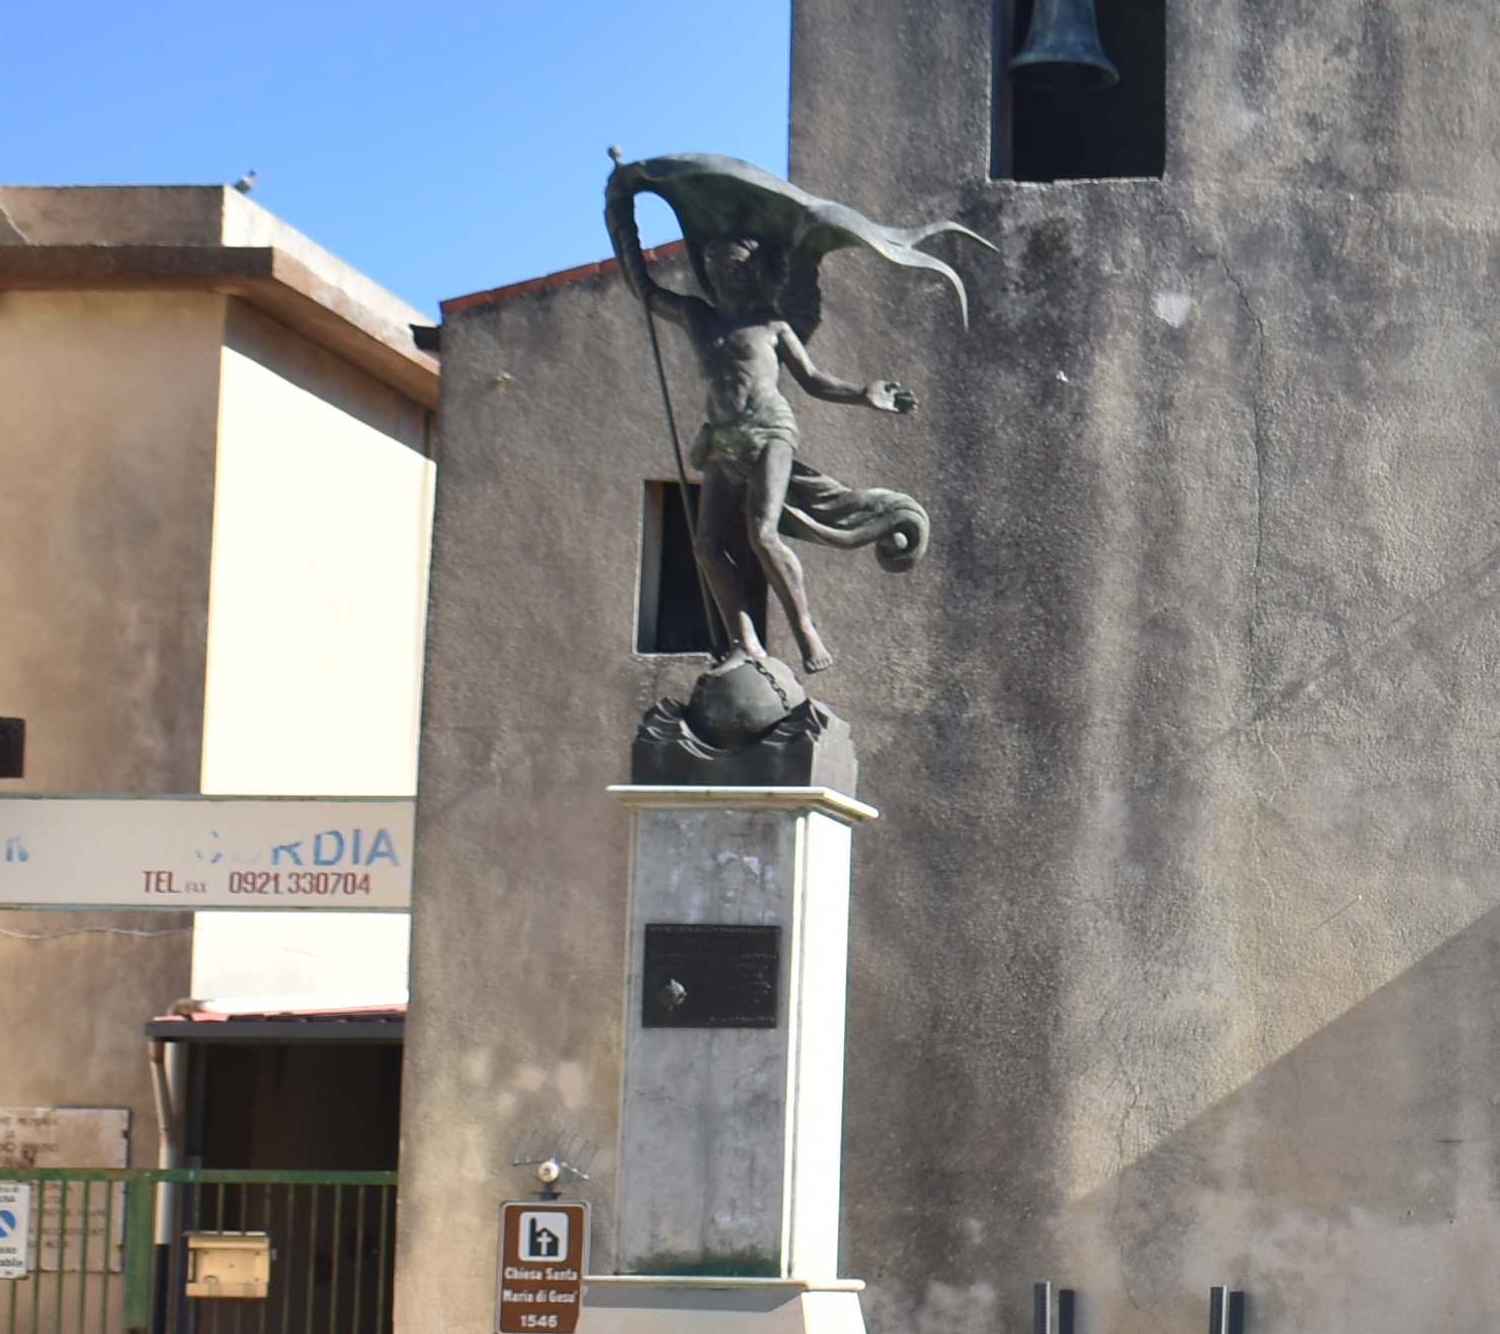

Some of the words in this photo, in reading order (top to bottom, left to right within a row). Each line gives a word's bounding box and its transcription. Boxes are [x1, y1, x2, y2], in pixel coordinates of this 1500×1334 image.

[504, 1266, 543, 1280] Chiesa
[545, 1267, 578, 1280] Santa
[503, 1289, 534, 1302] Maria
[535, 1289, 547, 1302] di
[520, 1314, 558, 1328] 1546
